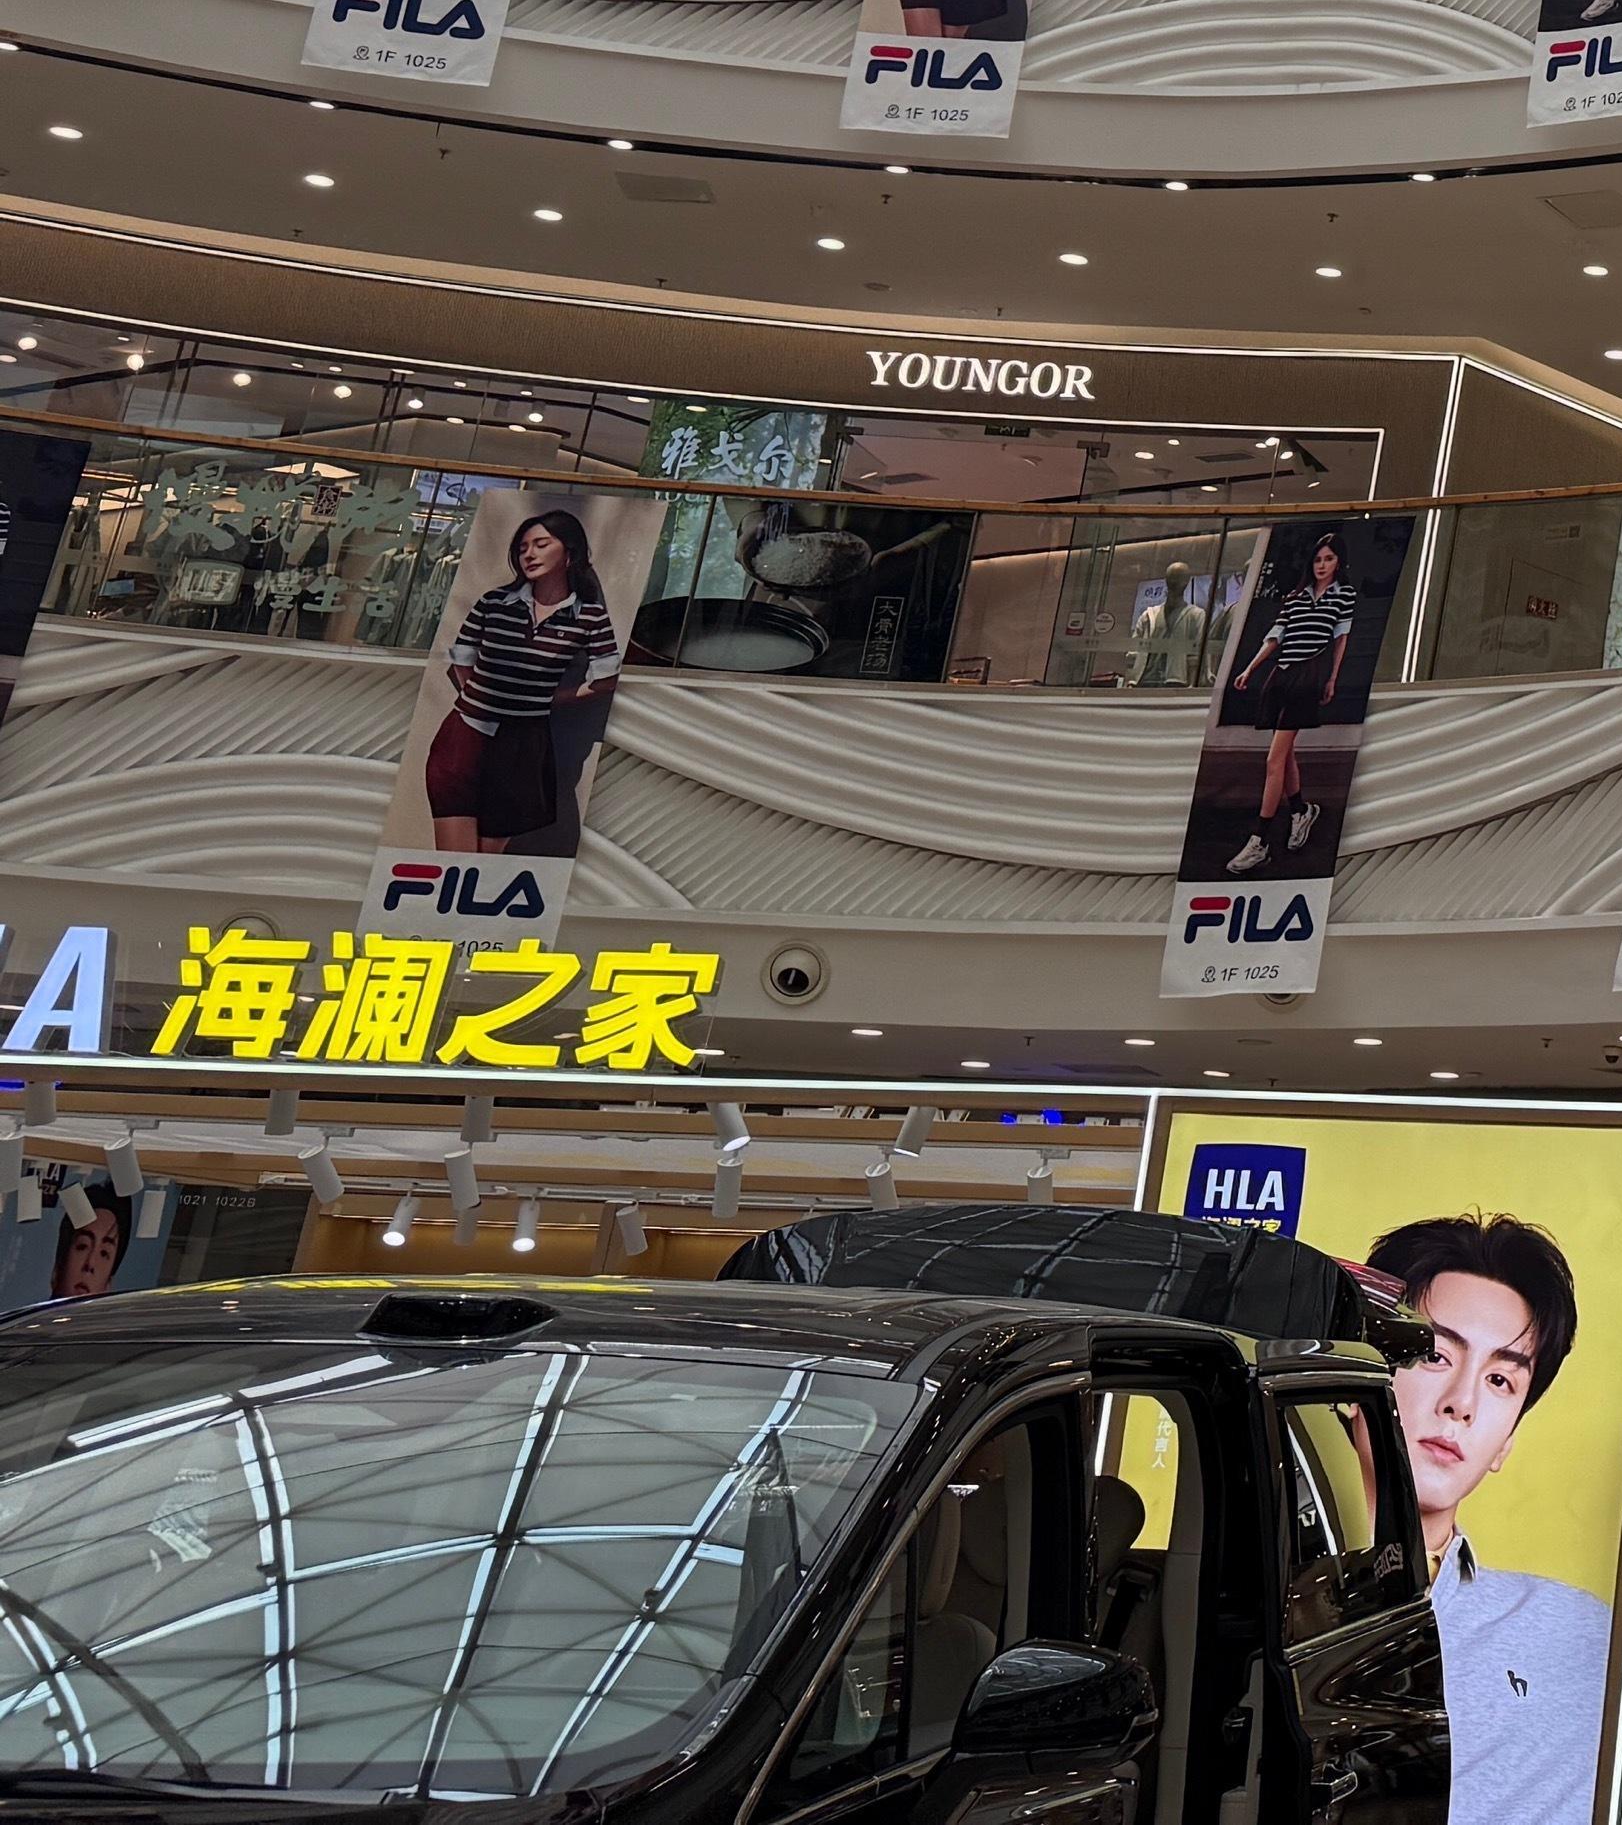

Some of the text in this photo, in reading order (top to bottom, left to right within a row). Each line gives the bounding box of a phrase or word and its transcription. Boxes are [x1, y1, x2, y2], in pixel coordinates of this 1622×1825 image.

[376, 50, 446, 69] 1F 1025
[865, 46, 1002, 90] FILA
[906, 108, 968, 121] 1F 1025
[1582, 96, 1596, 108] 1F
[866, 351, 1095, 400] YOUNGOR
[661, 426, 795, 481] 雅戈尔
[384, 864, 544, 918] FILA
[1184, 894, 1313, 944] FILA
[1221, 965, 1279, 981] 1F 1025
[151, 926, 720, 1068] 海澜之家
[1203, 1168, 1285, 1211] HLA
